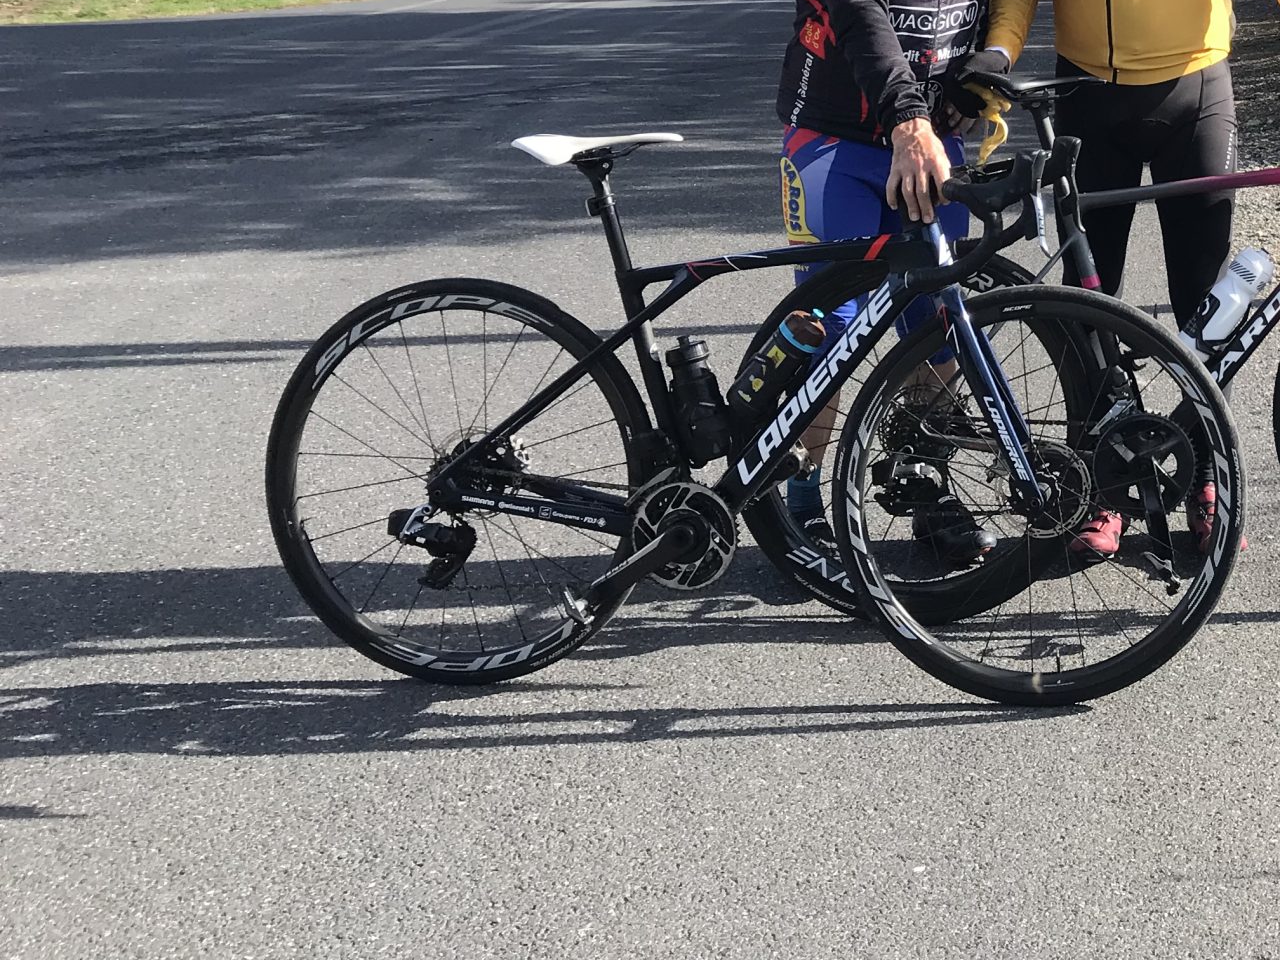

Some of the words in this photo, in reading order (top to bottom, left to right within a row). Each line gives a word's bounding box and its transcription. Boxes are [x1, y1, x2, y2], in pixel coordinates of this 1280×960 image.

[889, 6, 976, 31] MAGGIONI
[311, 294, 555, 391] SCOPE
[736, 281, 893, 486] LAPIERRE
[982, 395, 1031, 482] LAPIERRE
[1152, 354, 1231, 625] SCOPE
[369, 618, 575, 672] COPE
